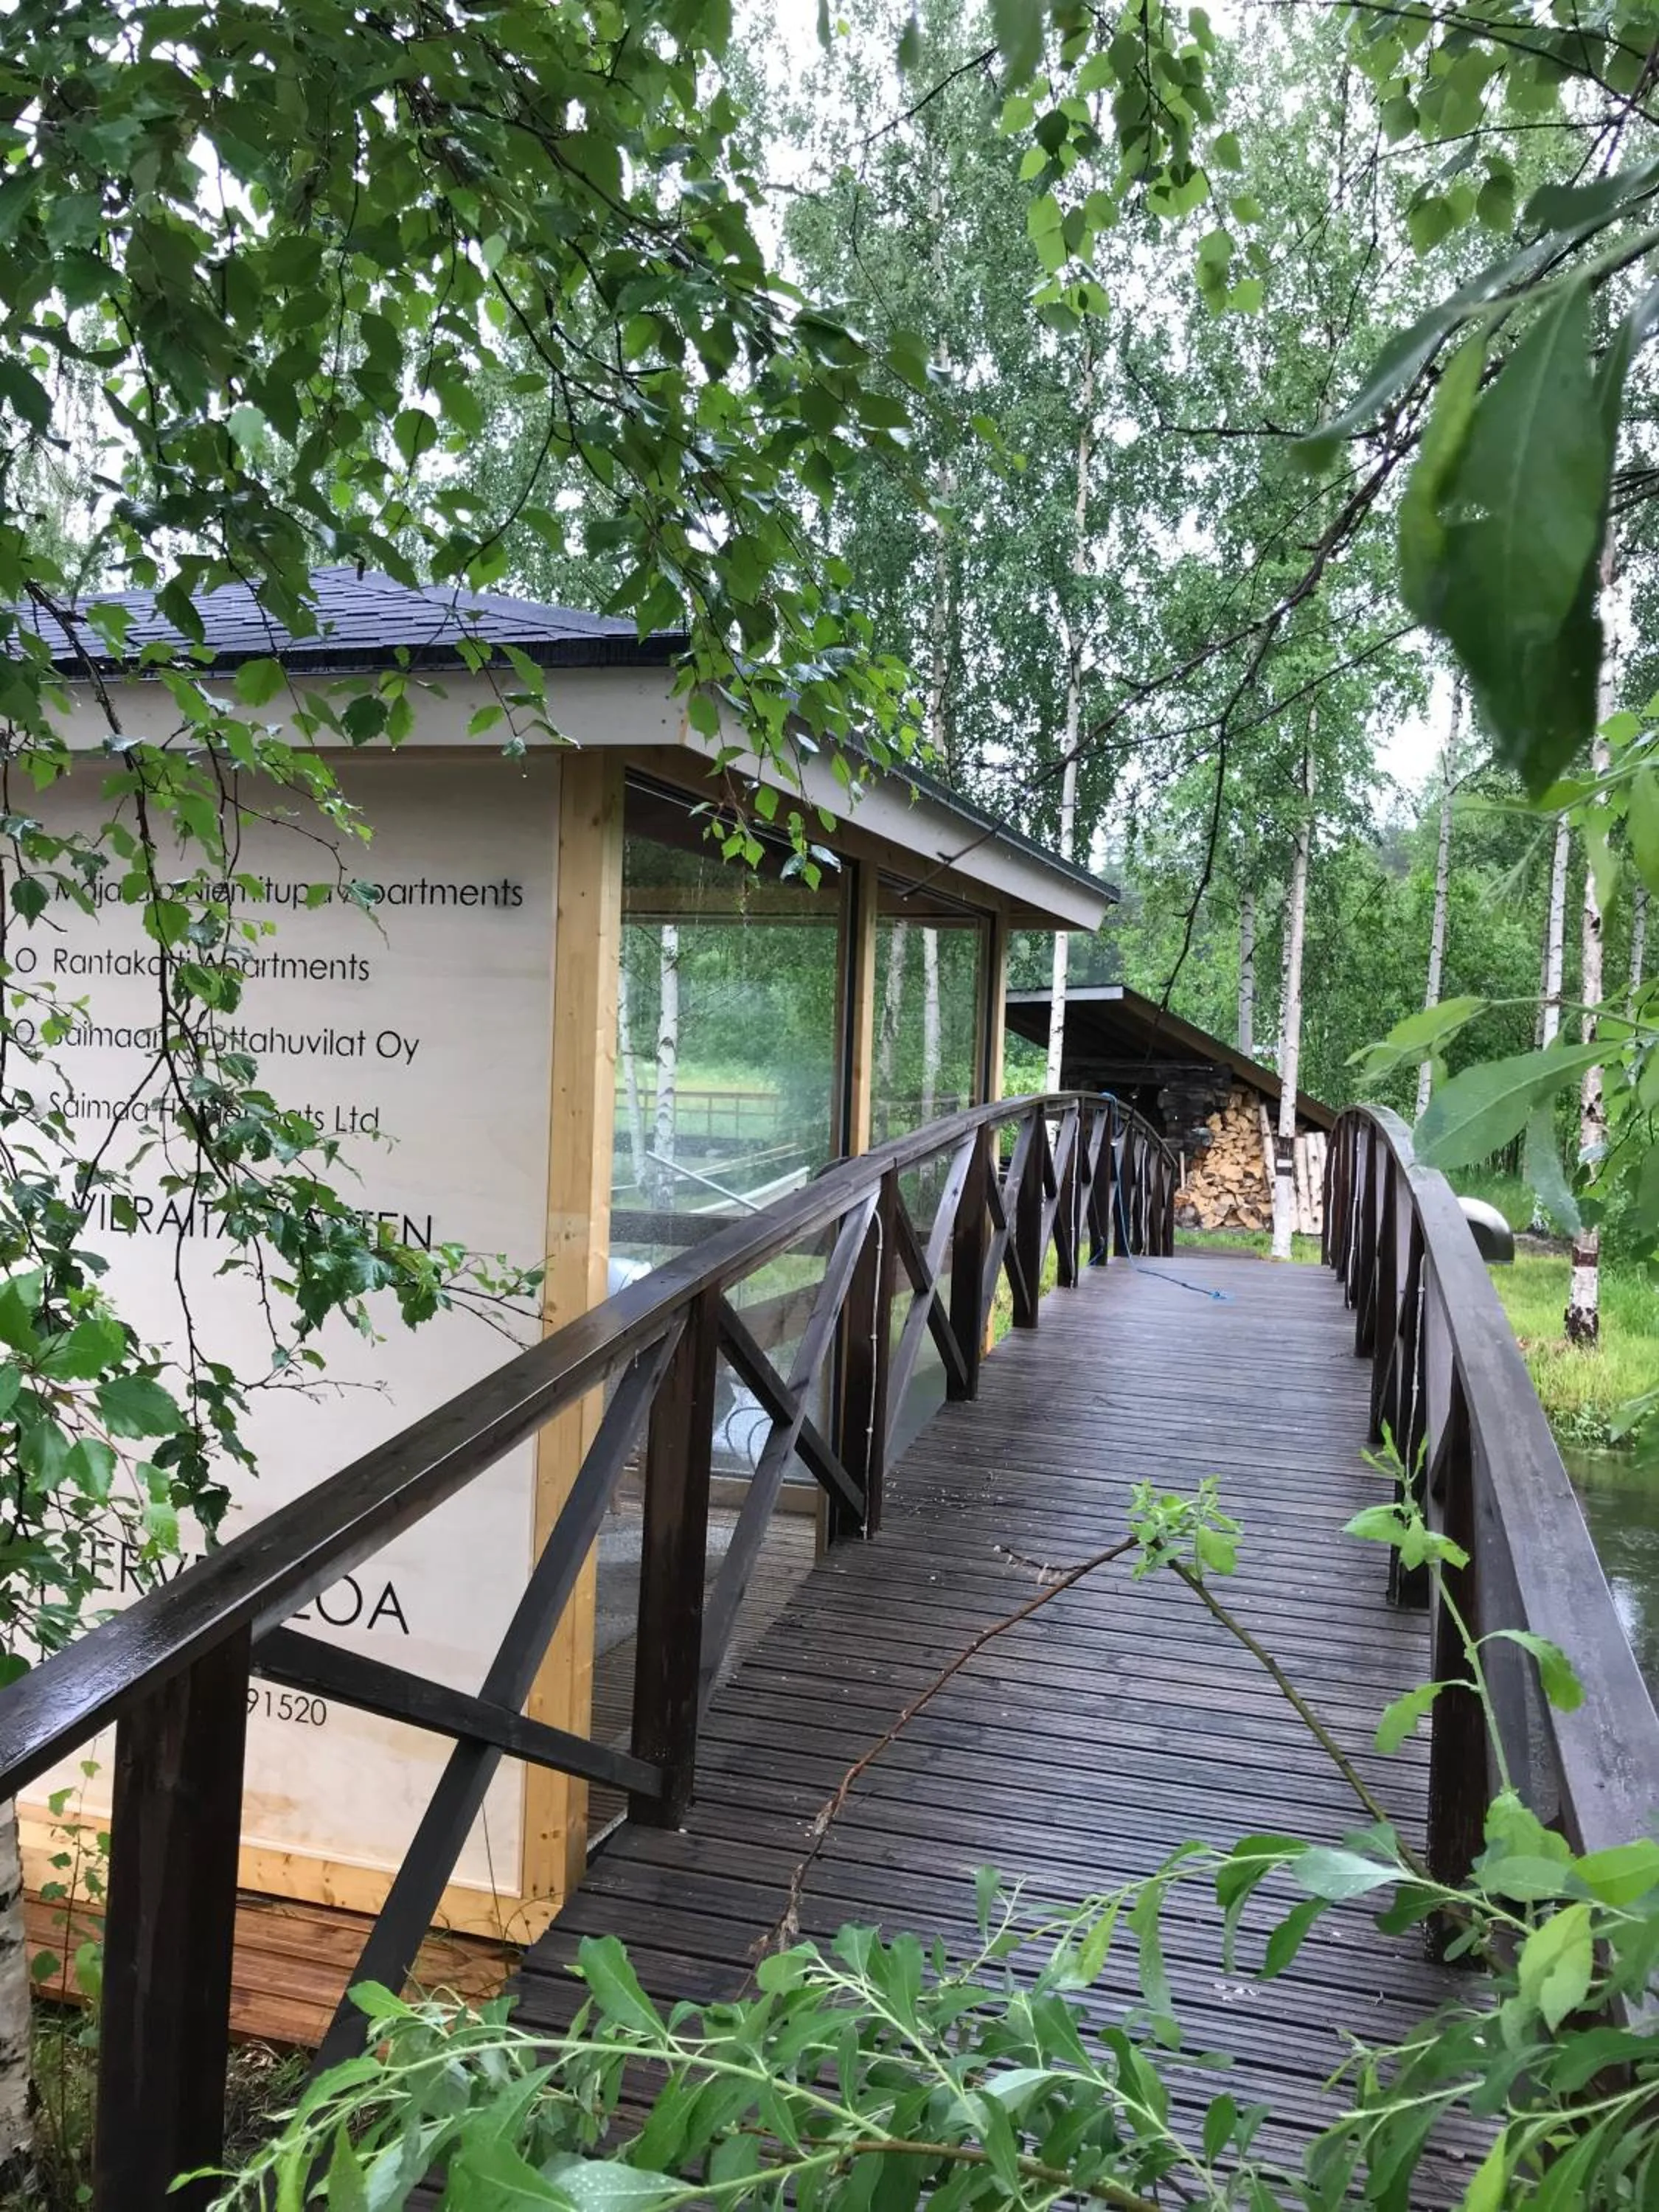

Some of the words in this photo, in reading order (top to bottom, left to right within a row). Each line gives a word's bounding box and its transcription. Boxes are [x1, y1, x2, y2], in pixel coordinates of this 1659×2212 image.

[55, 875, 175, 908] Majao
[186, 875, 332, 910] Niemtup
[342, 877, 524, 911] artments
[49, 1020, 168, 1049] aimaan
[179, 1023, 366, 1057] auttahuvilat
[376, 1030, 420, 1065] Oy
[49, 1092, 147, 1122] Saimaa
[335, 1105, 379, 1133] Ltd
